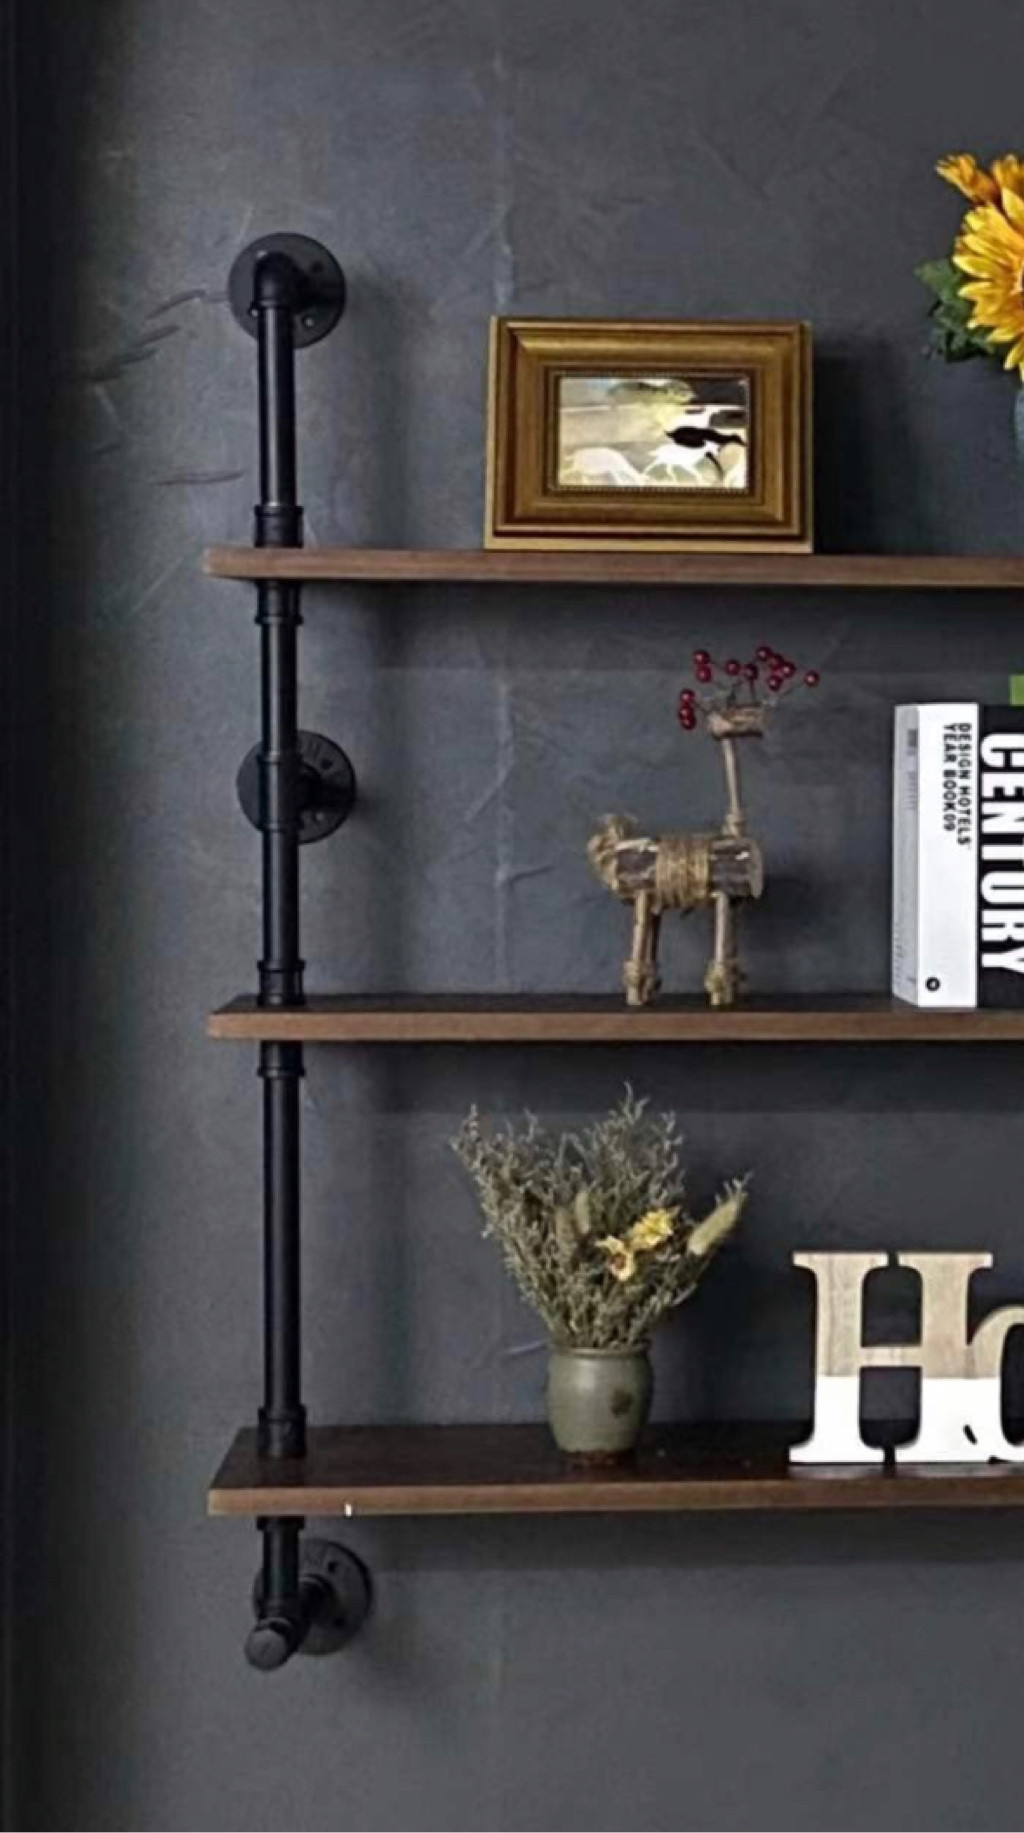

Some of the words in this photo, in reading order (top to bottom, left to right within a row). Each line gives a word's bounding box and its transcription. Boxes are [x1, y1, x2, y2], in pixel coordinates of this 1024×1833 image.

[943, 723, 957, 763] YEAR
[958, 723, 972, 780] DESIGN
[957, 785, 972, 846] HOTELS
